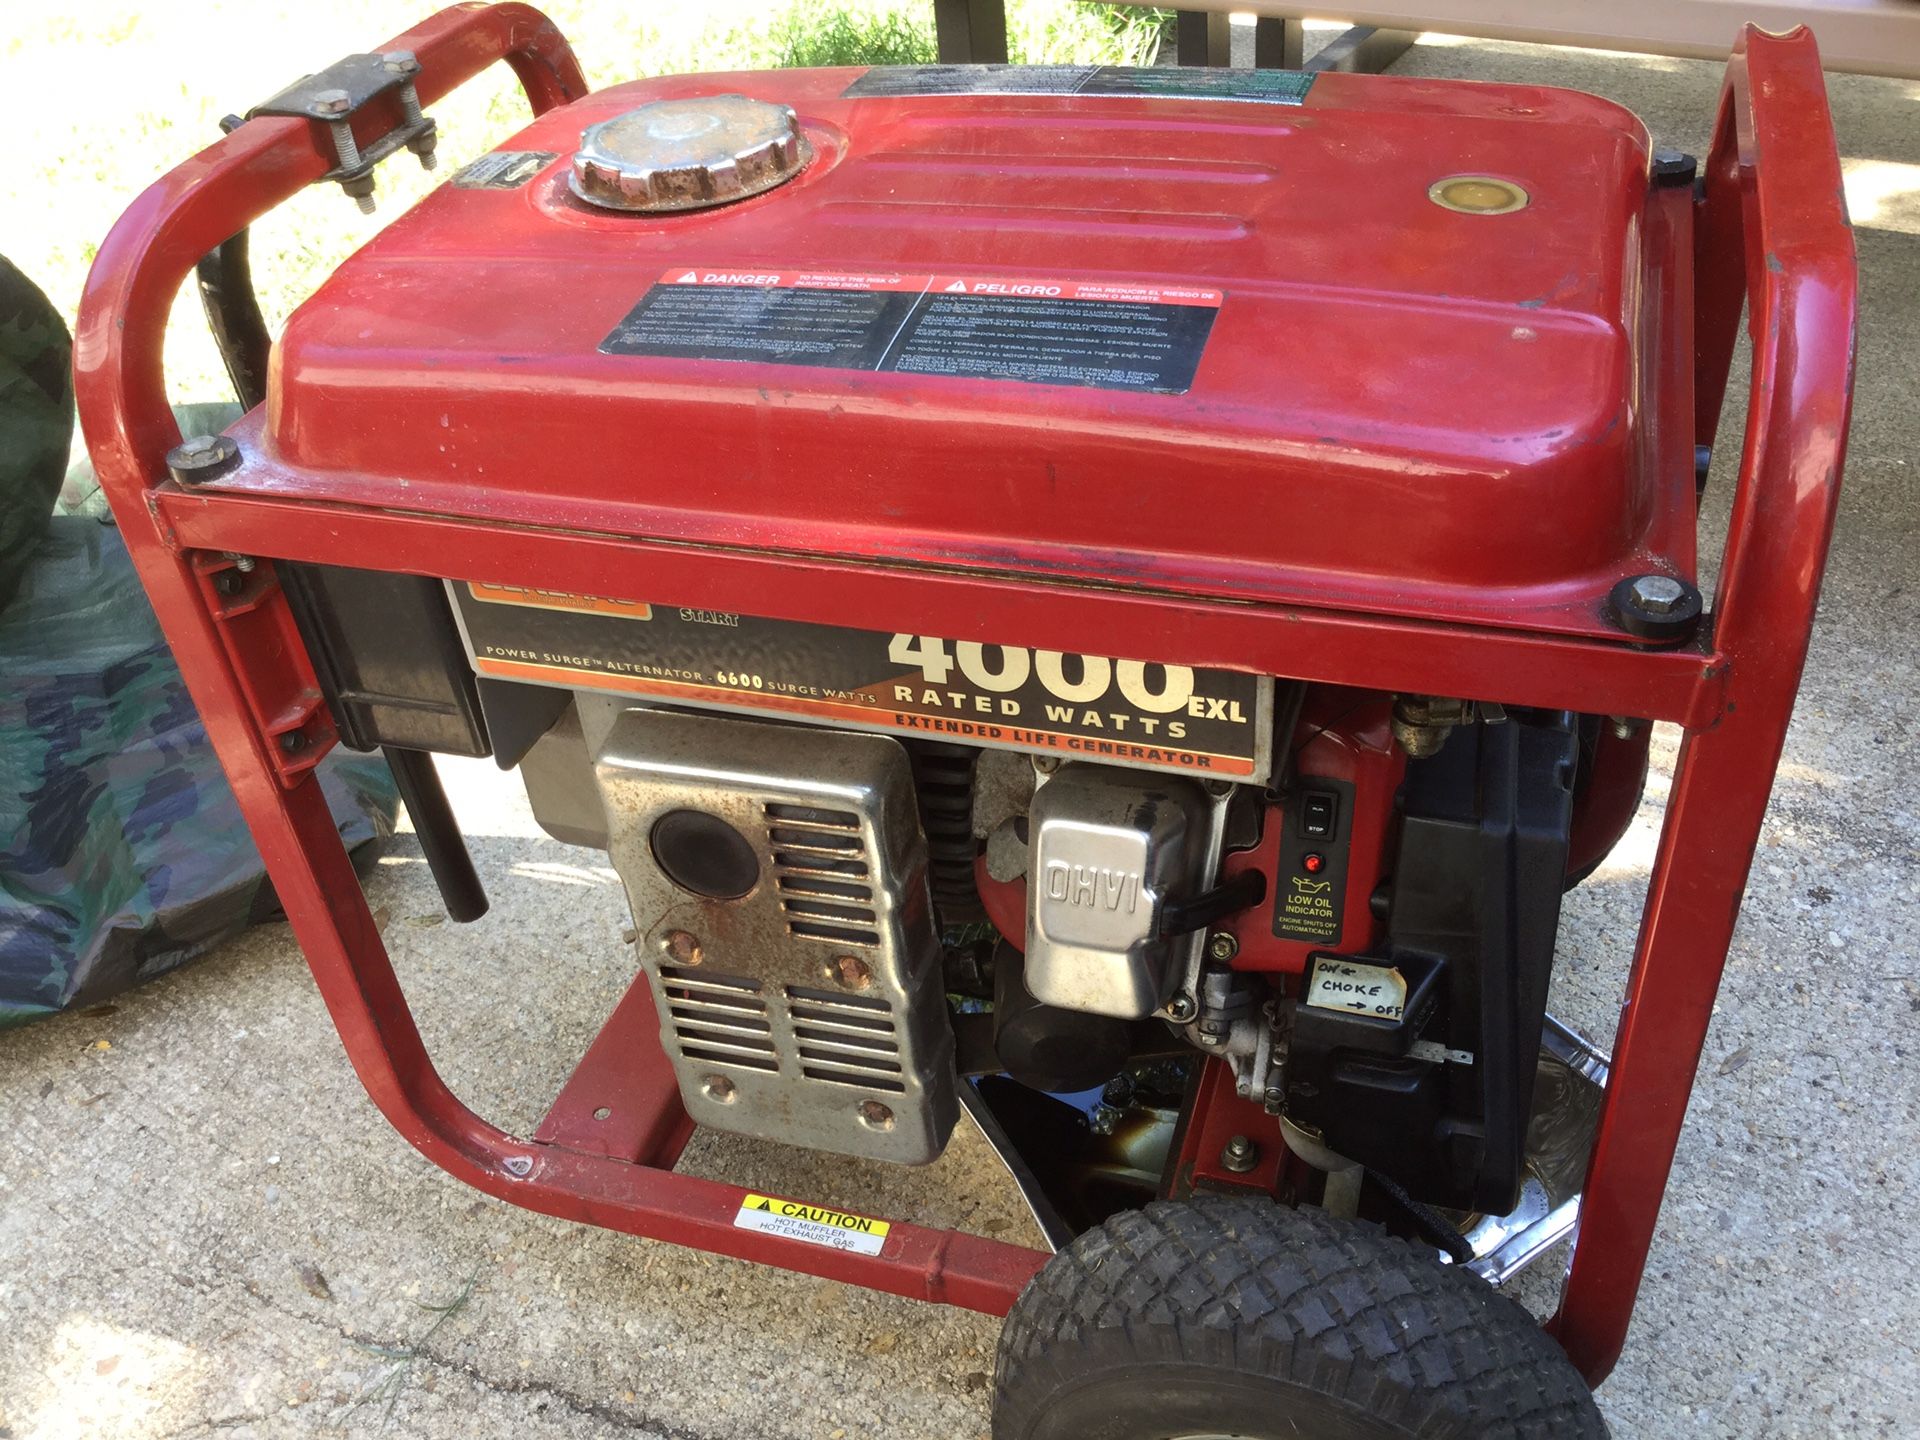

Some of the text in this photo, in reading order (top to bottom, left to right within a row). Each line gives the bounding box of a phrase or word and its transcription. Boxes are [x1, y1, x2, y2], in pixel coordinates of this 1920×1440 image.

[703, 274, 781, 285] DANGER
[973, 283, 1061, 296] PELIGRO
[1163, 290, 1199, 298] RIESGO
[680, 608, 740, 627] START
[486, 646, 538, 661] POWER
[607, 660, 703, 682] ALTERNATOR
[717, 671, 763, 690] 6600
[768, 681, 818, 697] SURGE
[822, 688, 877, 704] WATTS
[888, 632, 1247, 723] 4000 EXL
[894, 685, 1187, 739] RATED WATTS
[895, 714, 1211, 768] EXTENDED LIFE GENERATOR
[1047, 860, 1139, 914] OHVI
[1288, 894, 1332, 908] LOW OIL
[1286, 905, 1333, 918] INDICATOR
[1279, 916, 1337, 929] ENGINE SHUTS OFF
[1281, 924, 1334, 936] AUTOMATICALLY
[1322, 981, 1382, 996] CHOKE
[1375, 1005, 1403, 1018] OFF
[782, 1203, 872, 1232] CAUTION
[760, 1222, 855, 1248] HOT EXHAUST GAS
[775, 1217, 847, 1238] HOT MUFFLER
